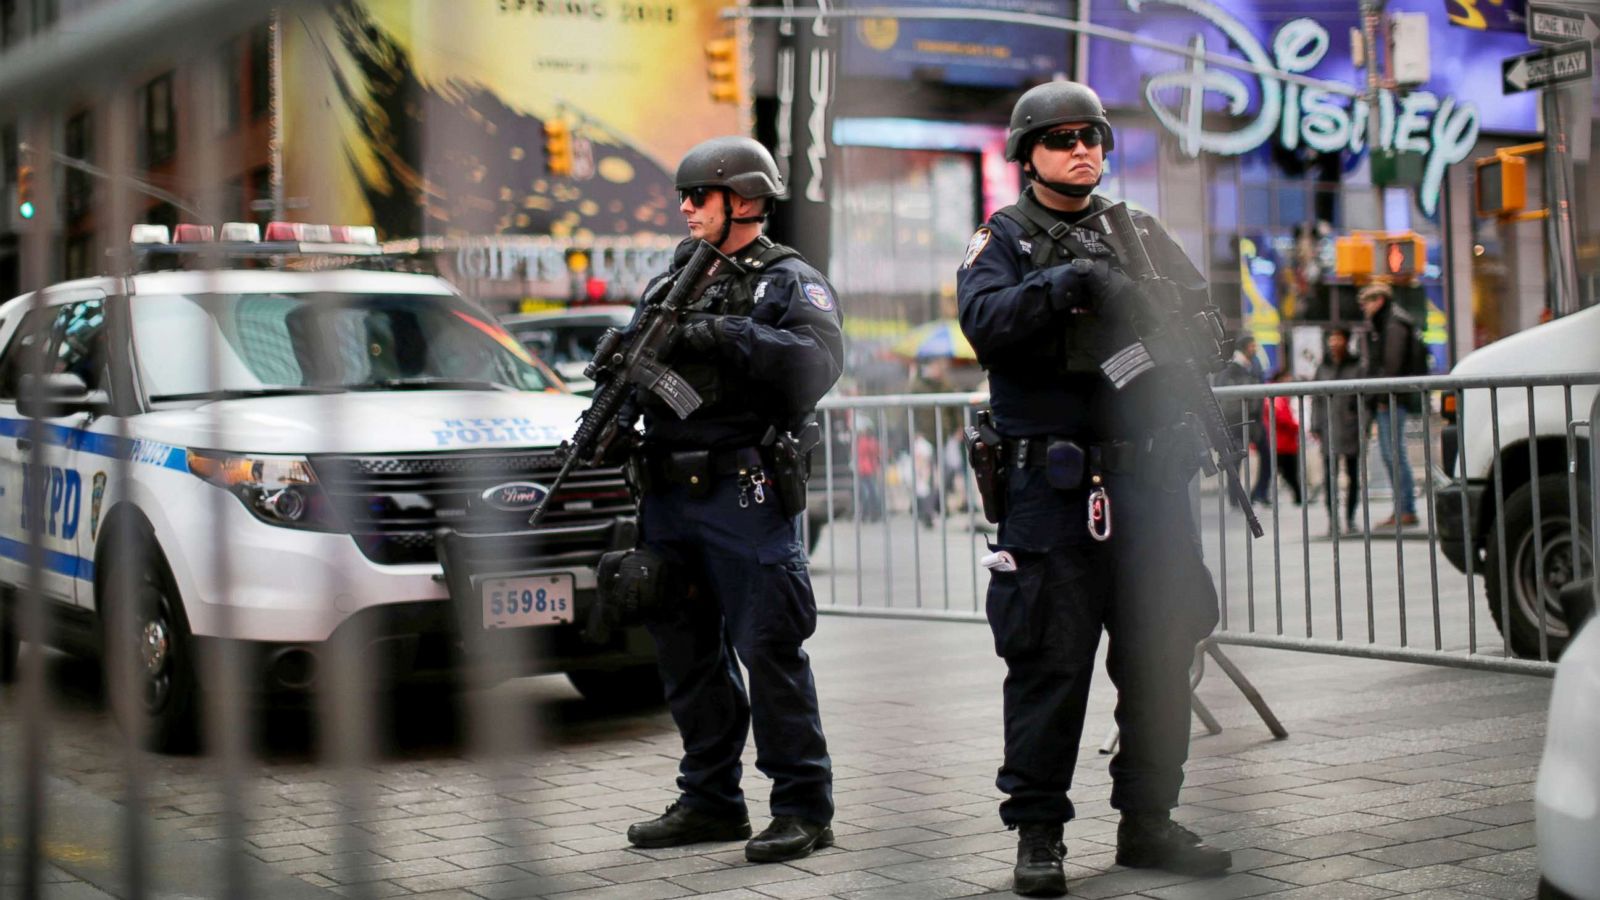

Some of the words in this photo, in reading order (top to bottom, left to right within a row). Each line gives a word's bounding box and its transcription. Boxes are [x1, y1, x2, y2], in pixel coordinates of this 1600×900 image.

[1562, 18, 1584, 36] WAY
[1555, 56, 1583, 75] WAY
[431, 426, 562, 445] POLICE
[501, 487, 537, 502] Ford
[491, 587, 548, 615] 5598
[550, 599, 567, 612] 15
